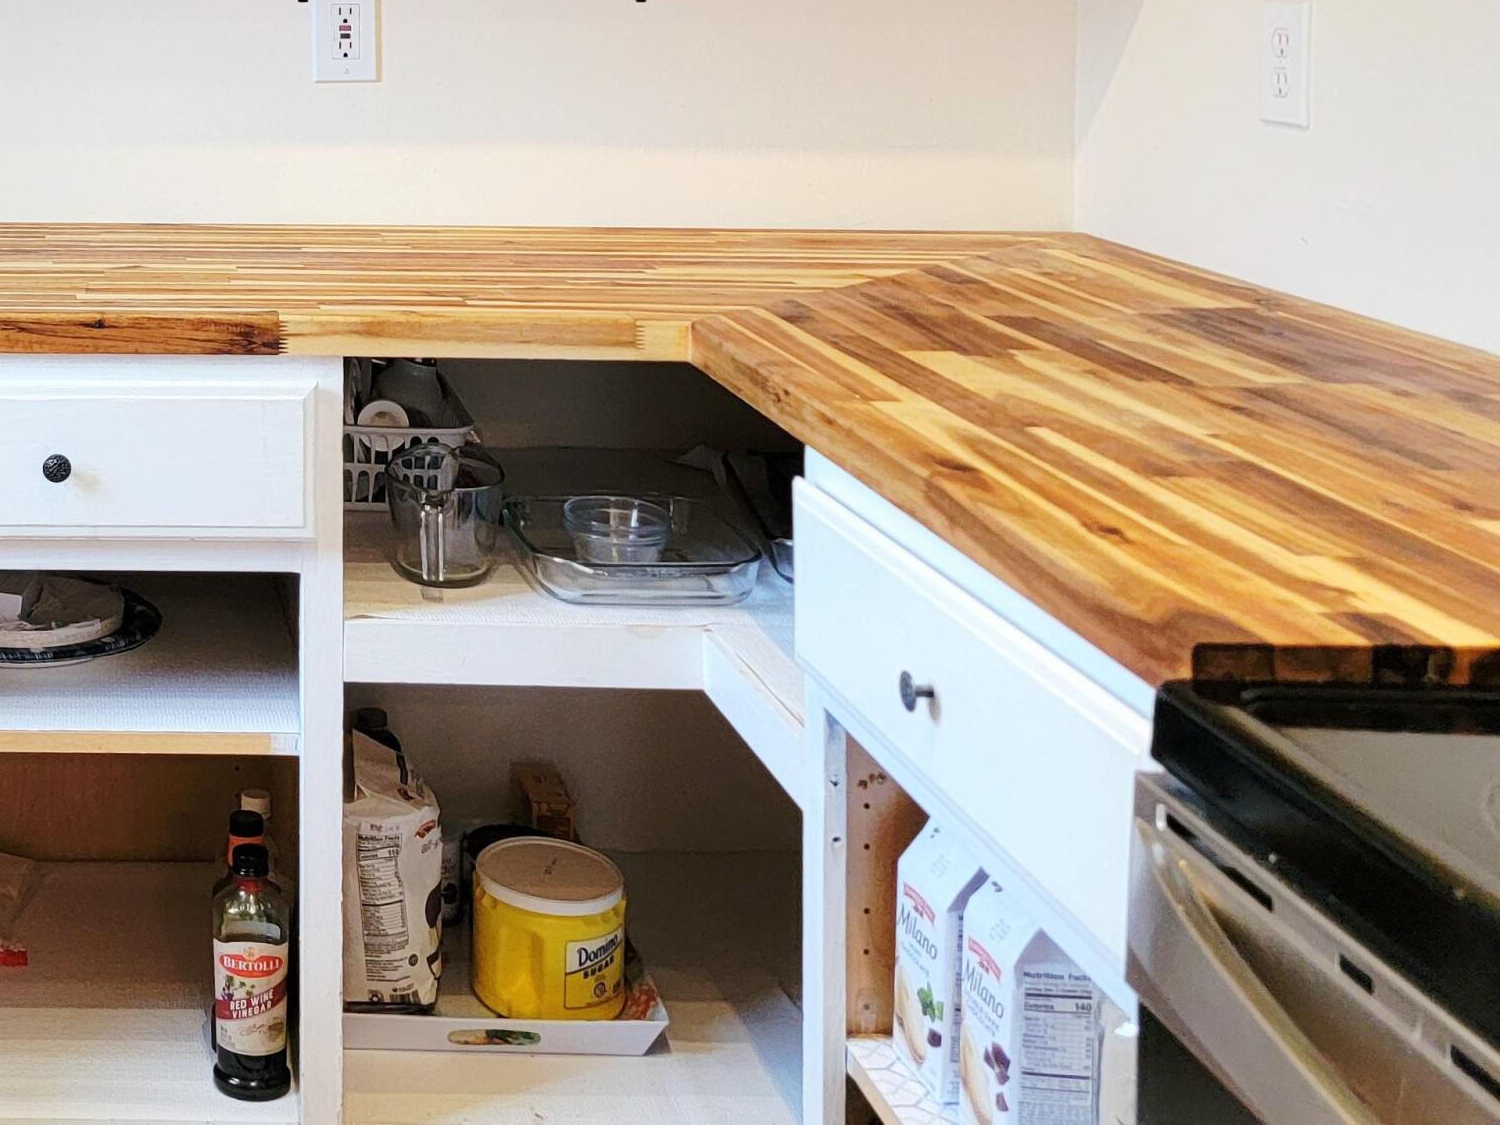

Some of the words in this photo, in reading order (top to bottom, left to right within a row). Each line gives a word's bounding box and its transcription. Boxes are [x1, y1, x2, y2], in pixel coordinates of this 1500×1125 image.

[897, 903, 938, 961] Milano
[577, 934, 618, 967] Domino
[223, 955, 280, 972] BERTOLLI
[583, 955, 614, 979] SUGAR
[230, 999, 247, 1011] RED
[250, 989, 274, 1006] WINE
[962, 959, 1004, 1019] Milano
[232, 1001, 272, 1020] VINEGAR
[1074, 1001, 1092, 1012] 140
